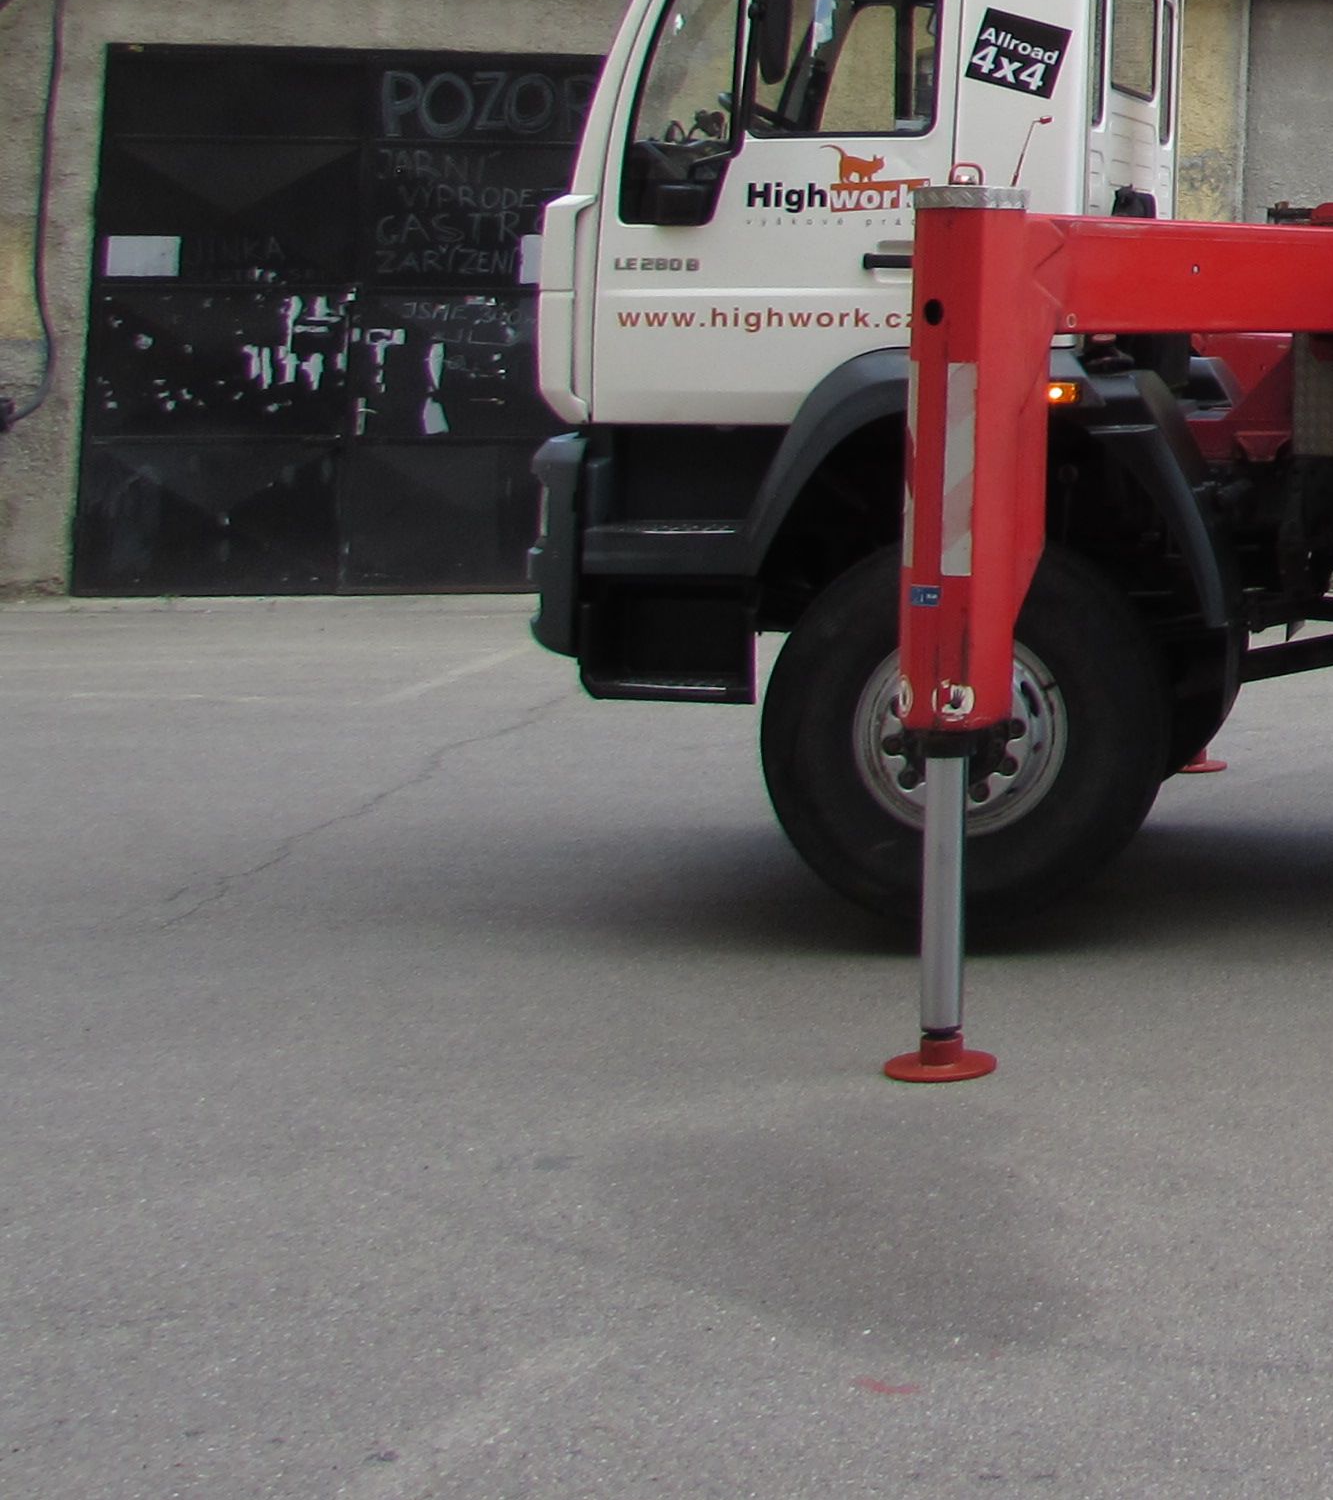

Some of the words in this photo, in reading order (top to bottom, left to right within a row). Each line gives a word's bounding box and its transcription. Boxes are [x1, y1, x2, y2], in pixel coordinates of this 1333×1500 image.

[980, 27, 1060, 65] Allroad
[972, 45, 1047, 91] 4x4
[614, 258, 638, 271] LE
[640, 258, 683, 271] 280
